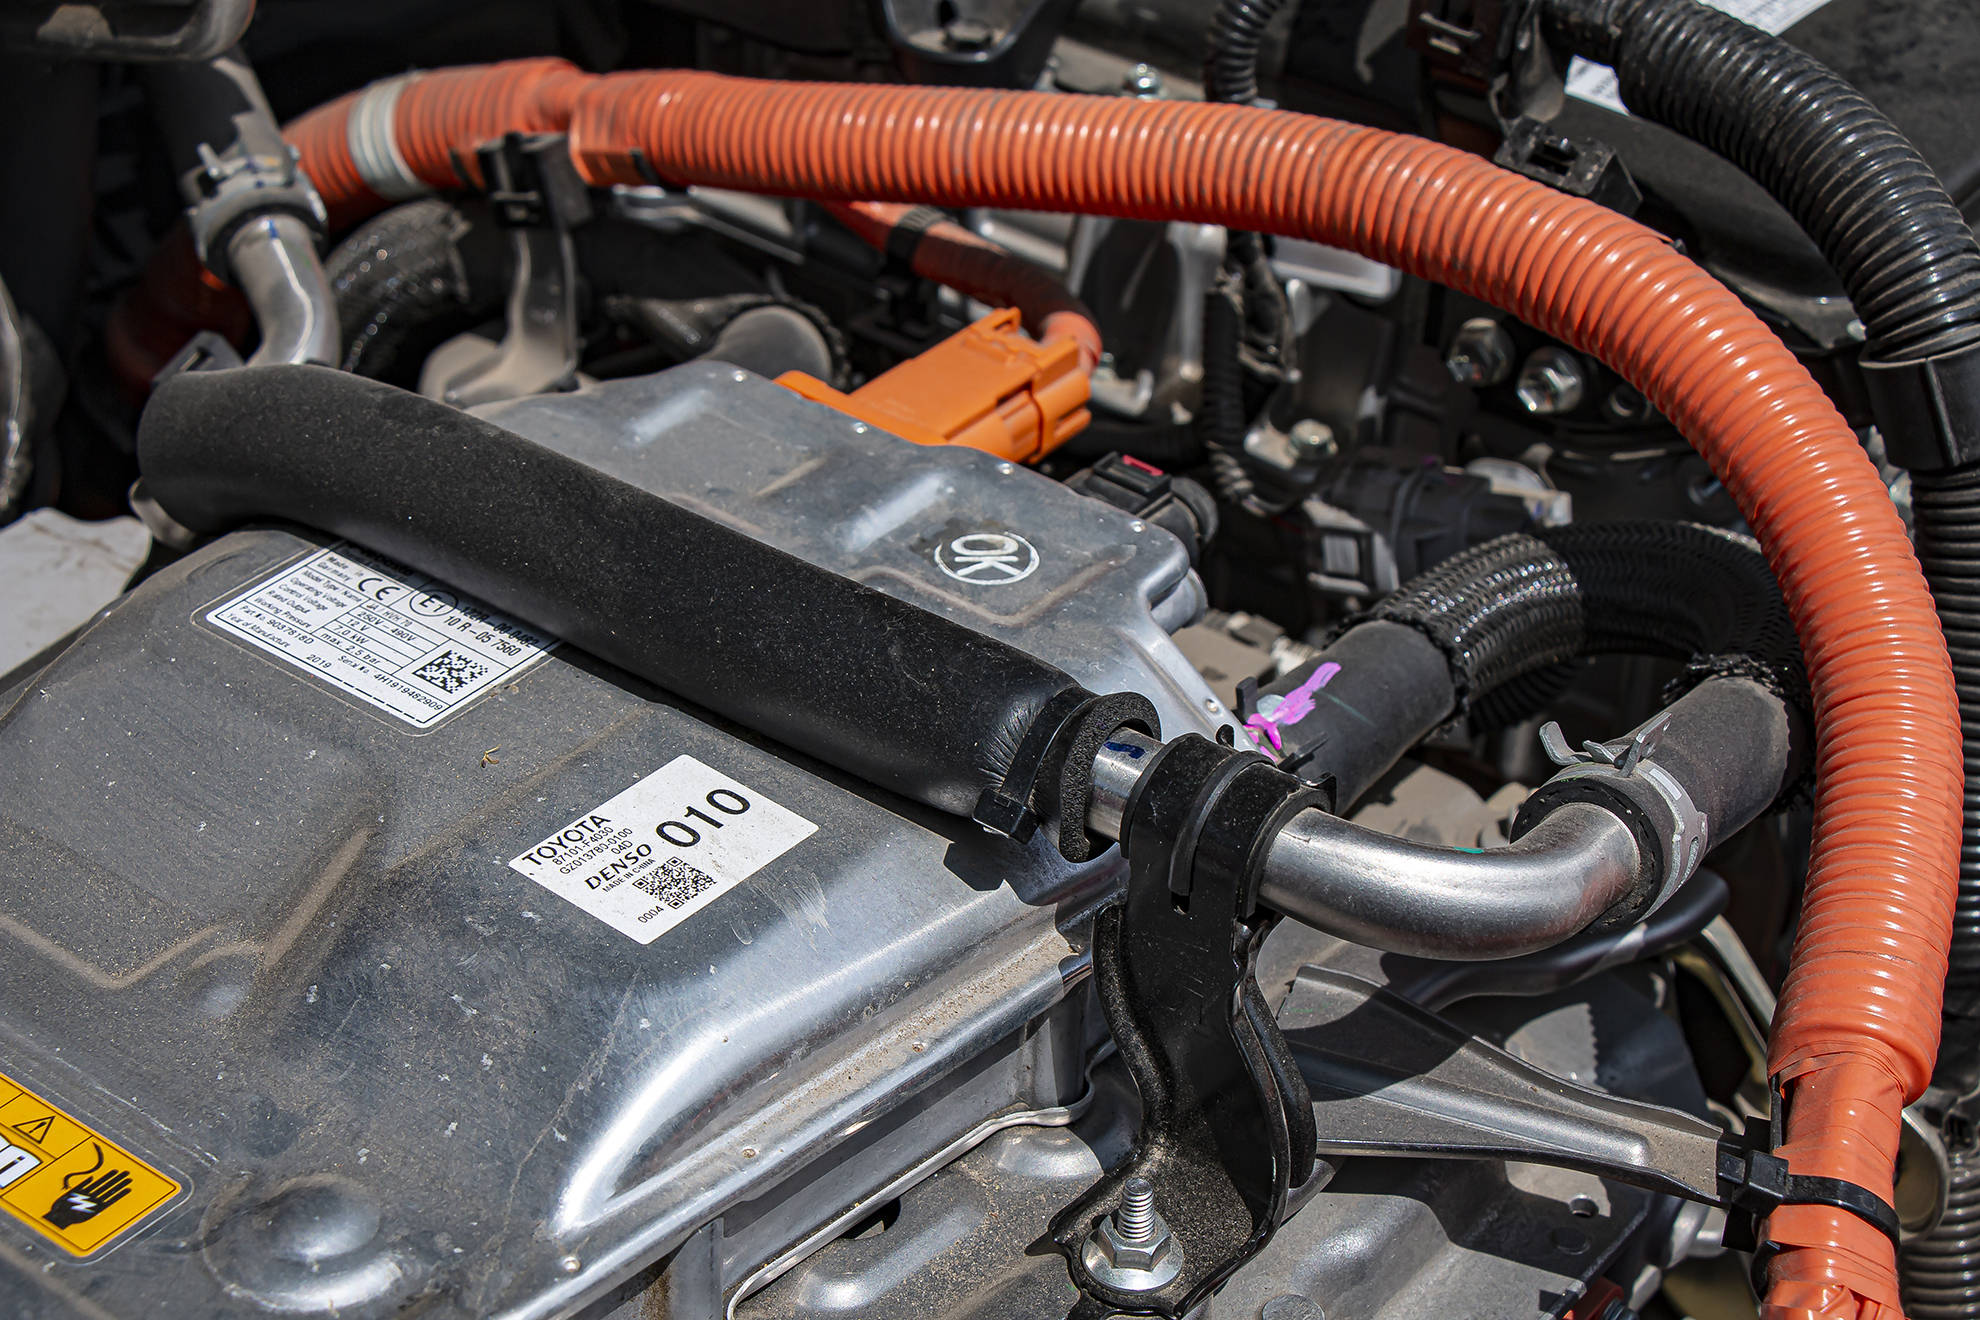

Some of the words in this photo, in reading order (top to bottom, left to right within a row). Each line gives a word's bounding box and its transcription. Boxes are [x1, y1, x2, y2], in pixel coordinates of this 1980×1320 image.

[951, 533, 1022, 576] OK
[347, 619, 360, 627] 12
[350, 634, 369, 644] kW
[444, 616, 461, 626] 10
[490, 638, 522, 656] 7560
[306, 654, 332, 668] 2019
[363, 654, 381, 664] bar
[656, 789, 751, 848] 010
[521, 814, 612, 866] TOYOTA
[552, 826, 614, 866] 87101-F4030
[610, 840, 633, 855] 04D
[584, 843, 652, 890] DENSO
[602, 877, 625, 892] MADE
[632, 858, 656, 874] CHINA
[638, 905, 664, 923] 0004
